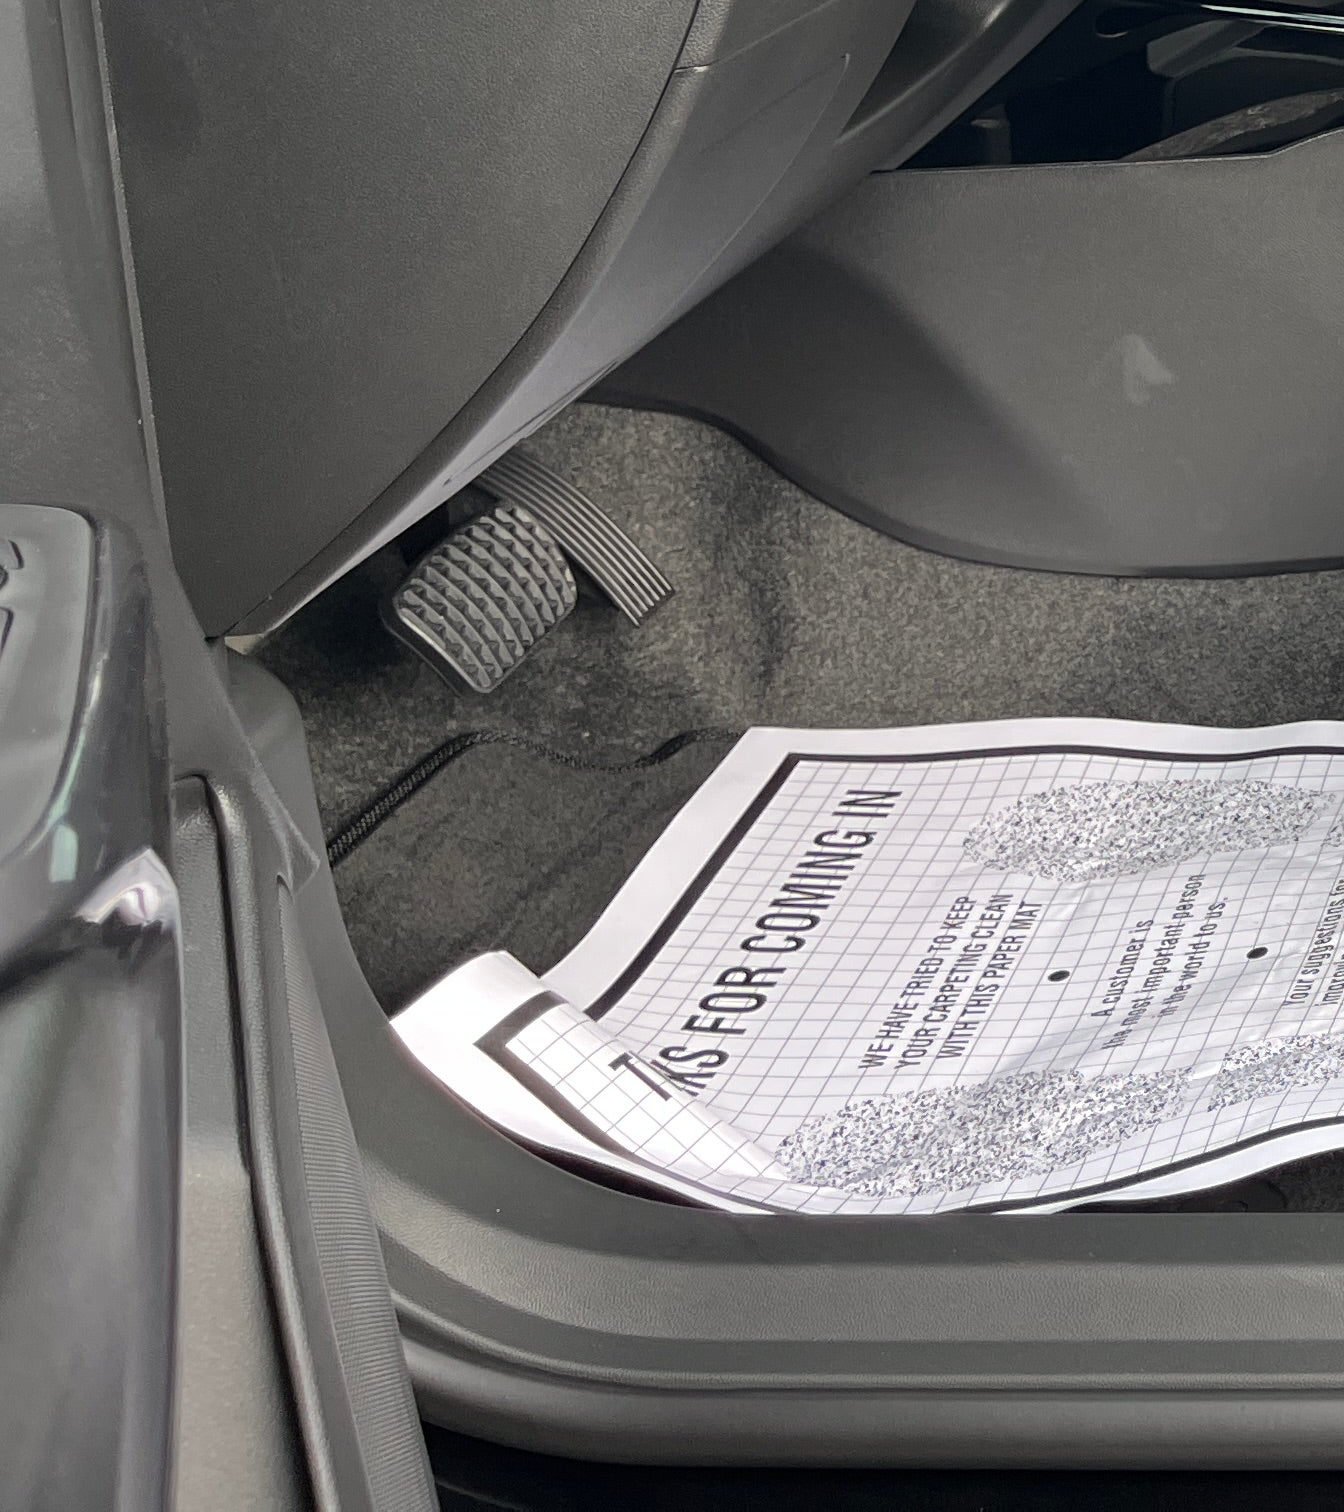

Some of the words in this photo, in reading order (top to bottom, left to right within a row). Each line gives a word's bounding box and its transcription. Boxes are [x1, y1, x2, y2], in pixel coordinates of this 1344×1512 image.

[681, 966, 787, 1035] FOR
[740, 829, 878, 954] COMING
[832, 789, 903, 818] IN
[939, 896, 976, 930] KEEP
[1172, 874, 1206, 920] person
[1204, 897, 1228, 920] us.
[1129, 920, 1154, 934] is
[1193, 923, 1218, 938] to
[927, 935, 957, 953] TO
[1134, 923, 1185, 994] important
[1102, 938, 1146, 1005] customer
[1179, 941, 1211, 981] world
[893, 1027, 941, 1069] YOUR
[923, 943, 988, 1023] CARPETING
[971, 894, 1013, 939] CLEAN
[900, 957, 944, 998] TRIED
[935, 1020, 980, 1059] WITH
[960, 984, 1000, 1018] THIS
[982, 935, 1027, 978] PAPER
[1008, 901, 1042, 930] MAT
[1282, 978, 1315, 1006] Your
[1121, 996, 1153, 1026] most
[1161, 984, 1192, 1006] the
[875, 1002, 919, 1038] HAVE
[1090, 1007, 1115, 1017] A
[1151, 1005, 1179, 1019] in
[858, 1043, 894, 1069] WE
